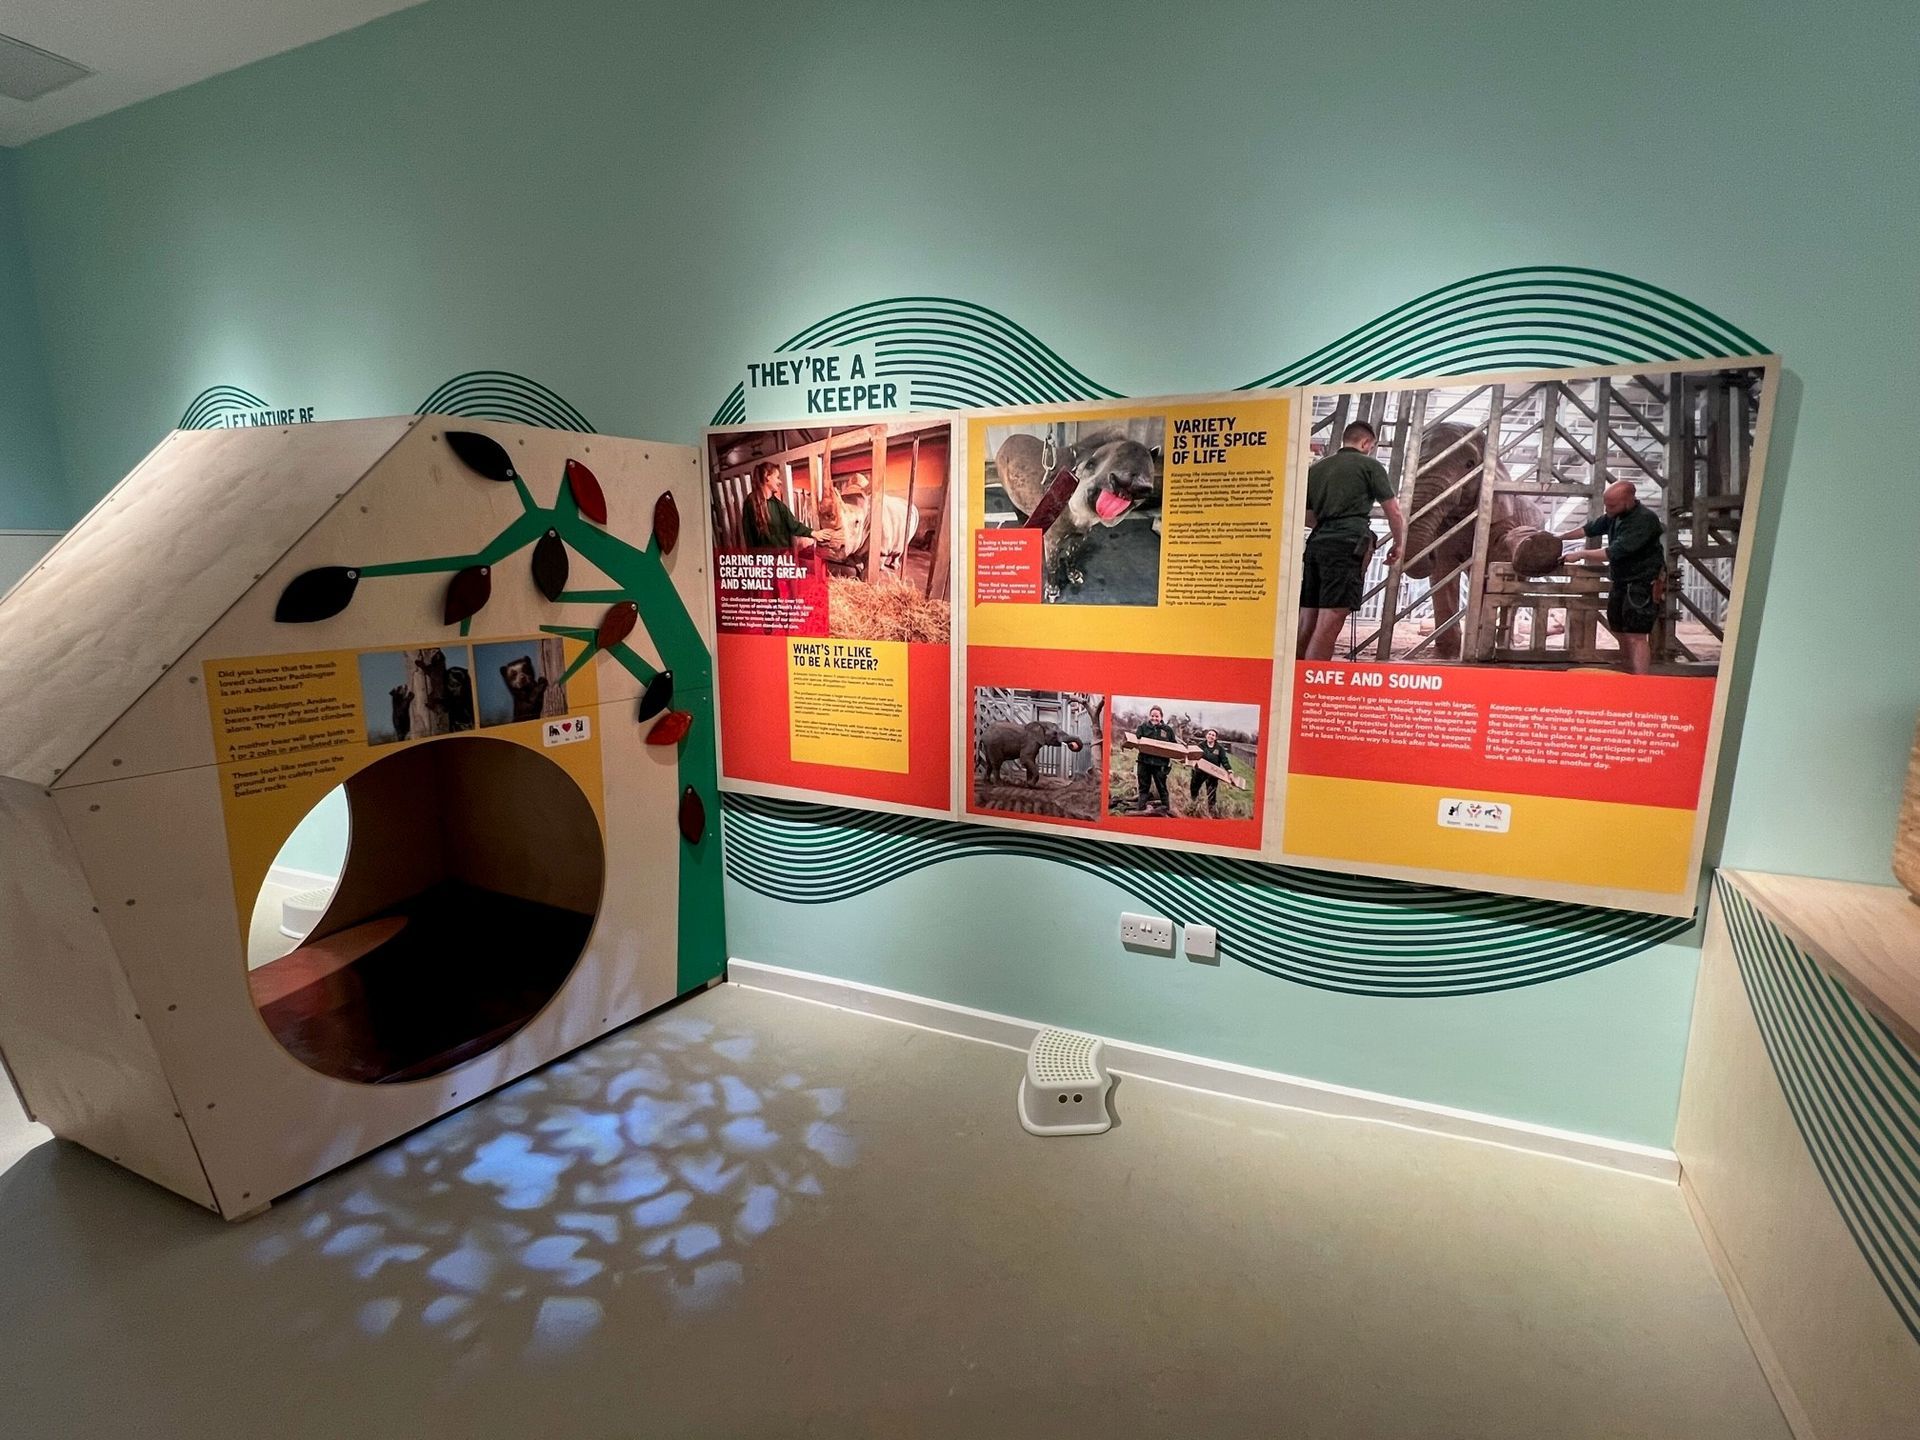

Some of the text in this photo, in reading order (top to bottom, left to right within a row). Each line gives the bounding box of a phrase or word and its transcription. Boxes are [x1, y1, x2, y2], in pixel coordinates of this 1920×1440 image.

[748, 354, 865, 388] THEY'RE A
[808, 383, 896, 413] KEEPER
[250, 409, 294, 426] NATURE
[300, 407, 314, 423] BE
[1174, 417, 1236, 433] VARIETY
[1173, 432, 1266, 449] IS THE SPICE
[1172, 450, 1226, 464] OF LIFE
[719, 555, 795, 566] CARING FOR ALL
[720, 567, 807, 578] CREATURES GREAT
[721, 579, 773, 590] AND SMALL
[793, 644, 871, 658] WHAT'S IT LIKE
[794, 656, 878, 670] TO BE A KEEPER?
[1305, 670, 1442, 690] SAFE AND SOUND
